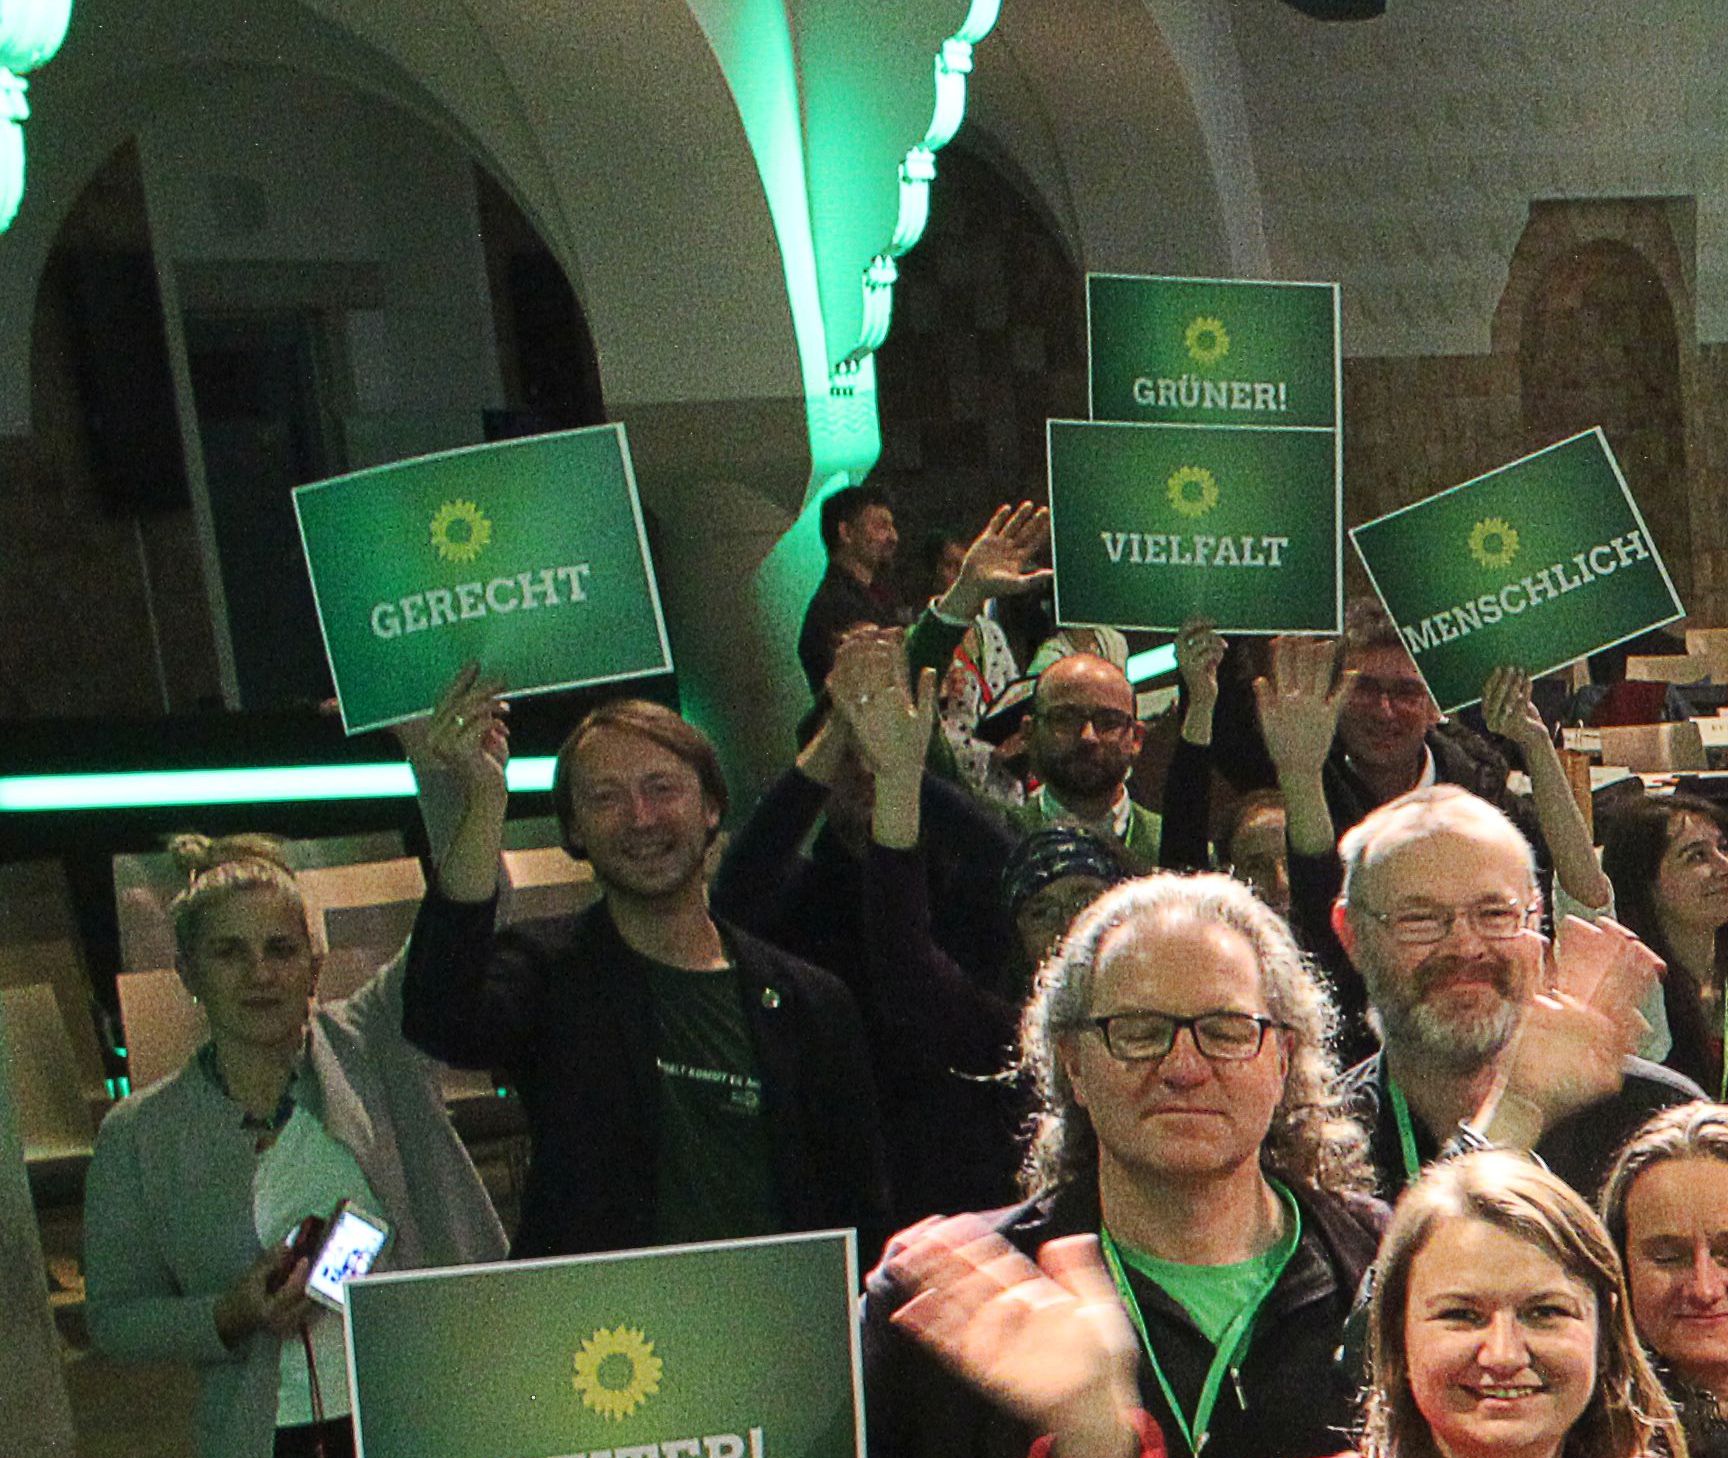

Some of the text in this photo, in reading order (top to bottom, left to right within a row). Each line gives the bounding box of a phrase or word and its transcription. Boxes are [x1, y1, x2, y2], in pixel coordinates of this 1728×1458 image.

[1134, 374, 1286, 410] GRÜNER!
[1102, 532, 1288, 565] VIELFALT
[372, 564, 589, 637] GERECHT
[1405, 530, 1649, 654] MENSCHLICH
